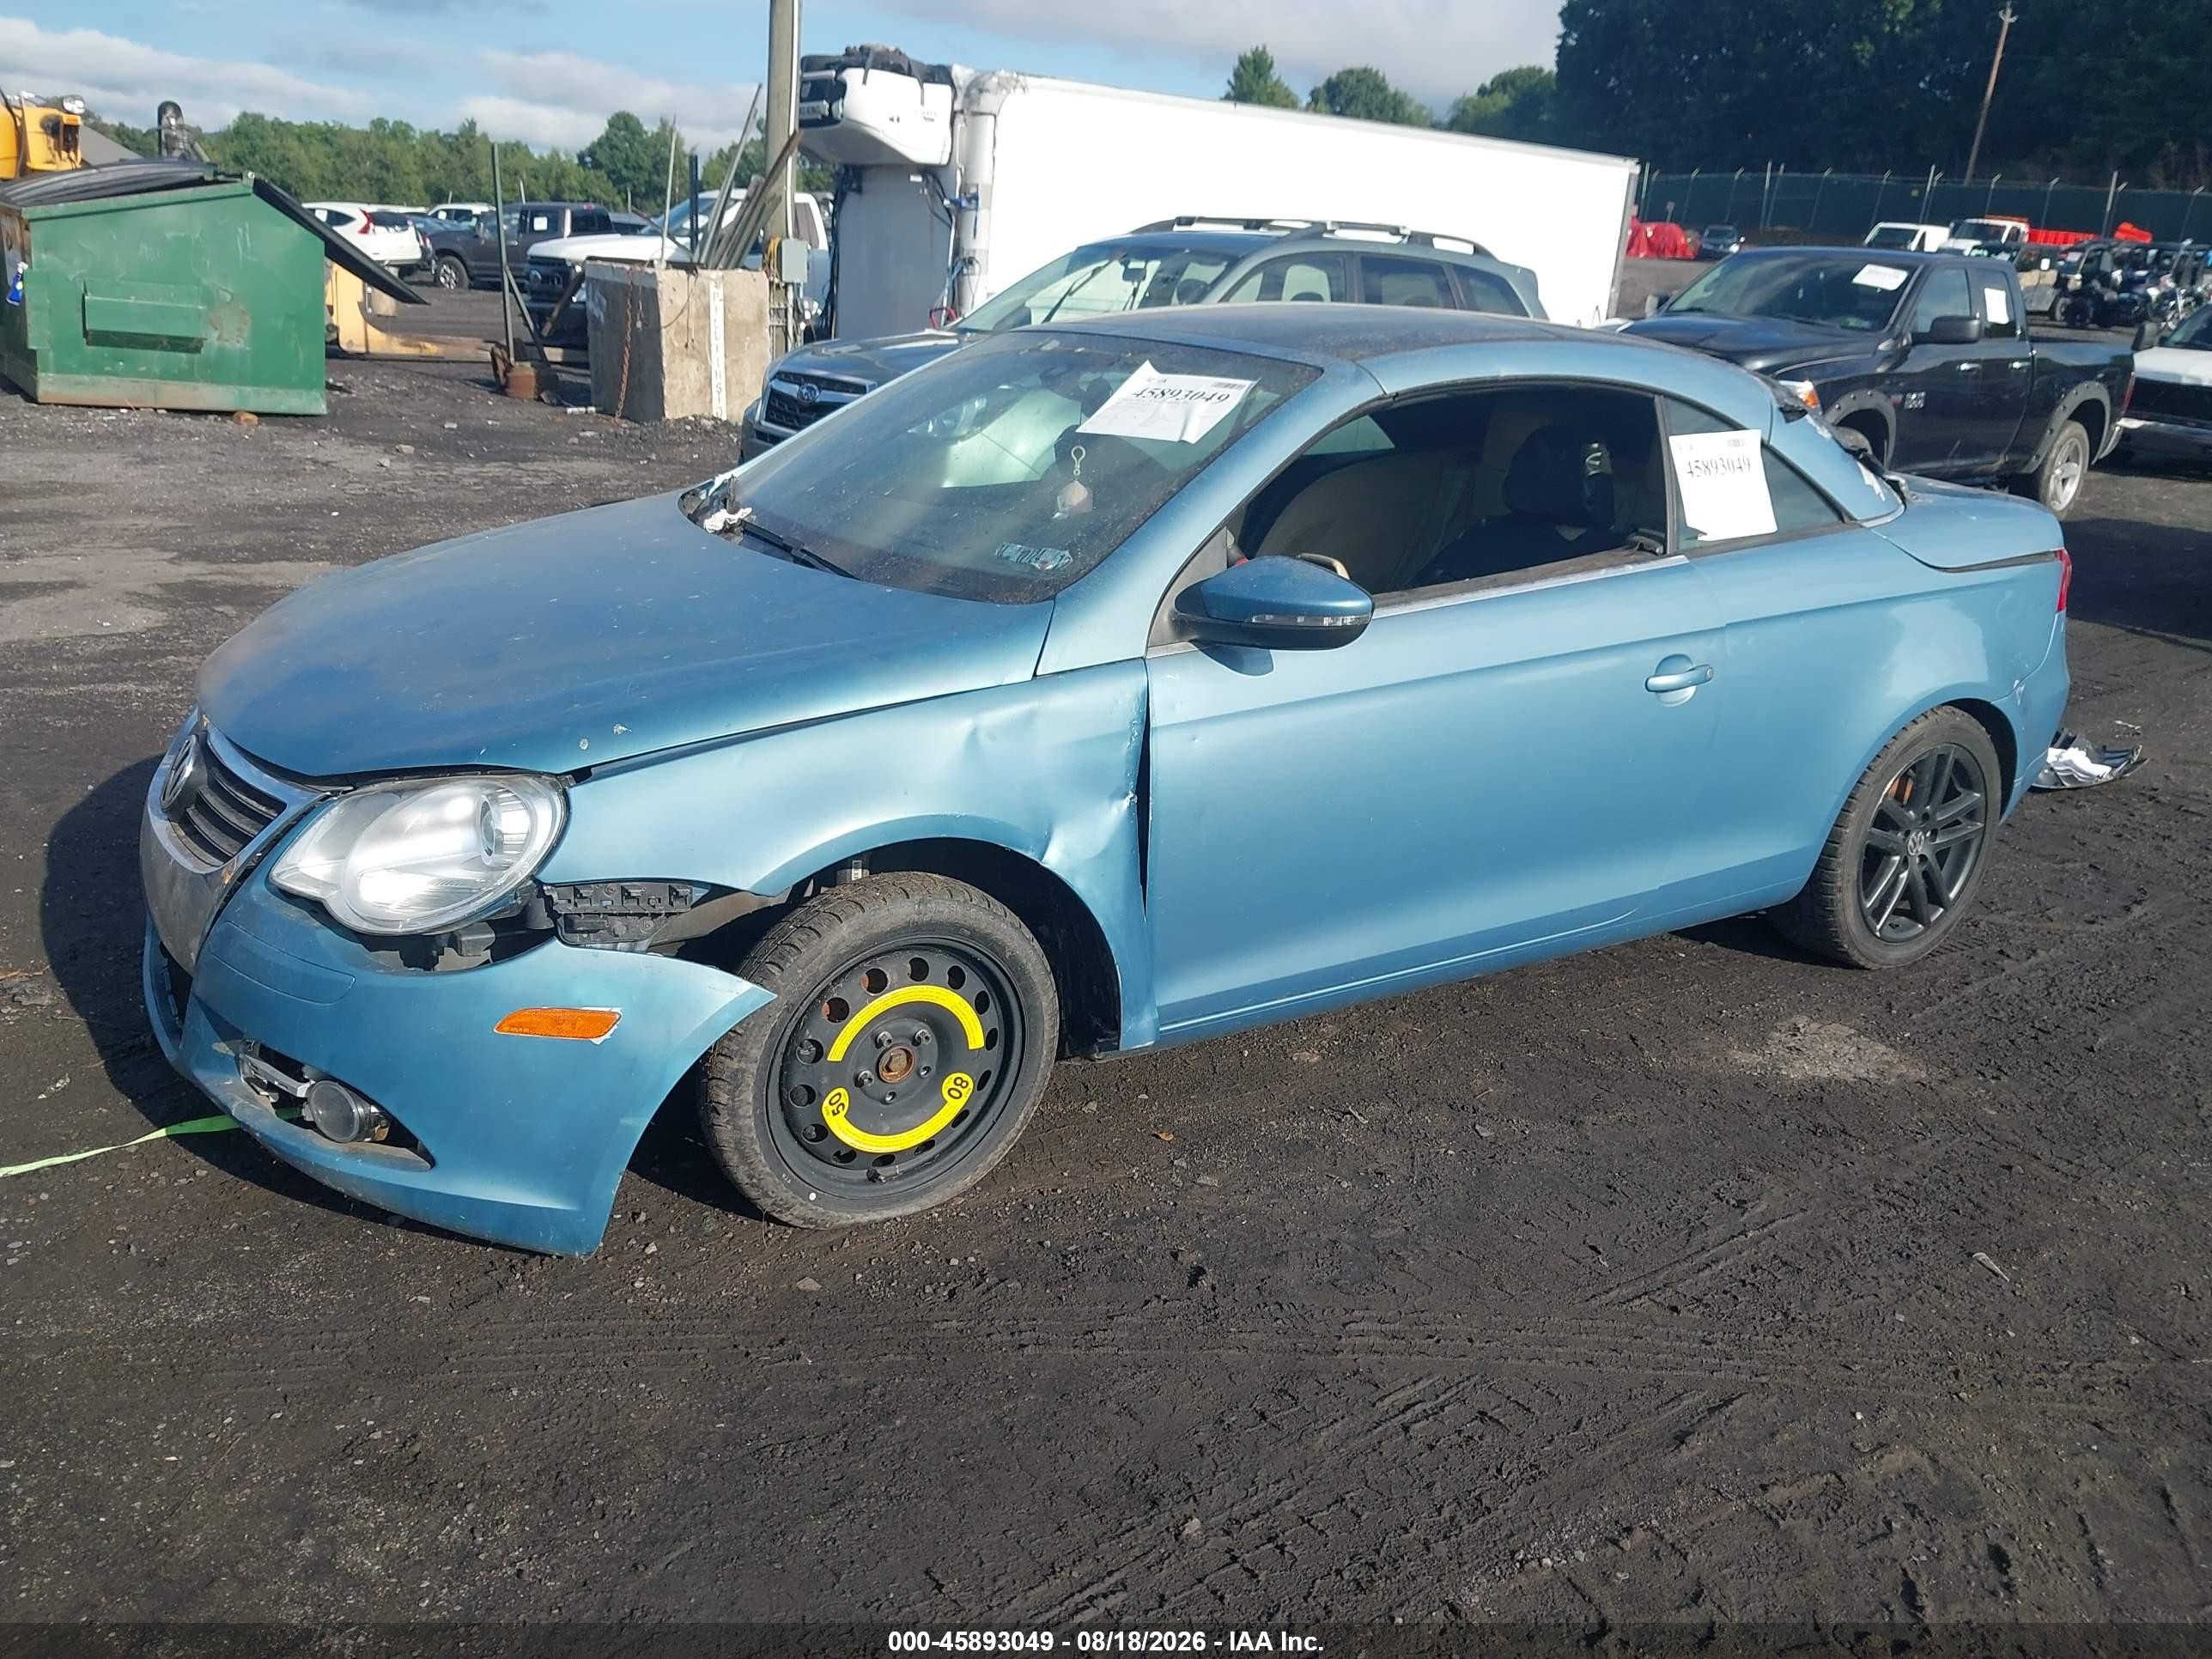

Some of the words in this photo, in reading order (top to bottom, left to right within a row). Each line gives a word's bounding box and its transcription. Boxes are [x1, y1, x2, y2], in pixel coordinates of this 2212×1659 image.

[1133, 386, 1231, 404] 45893049
[1686, 455, 1752, 478] 45893049
[948, 1076, 969, 1100] 80
[829, 1092, 845, 1116] 50
